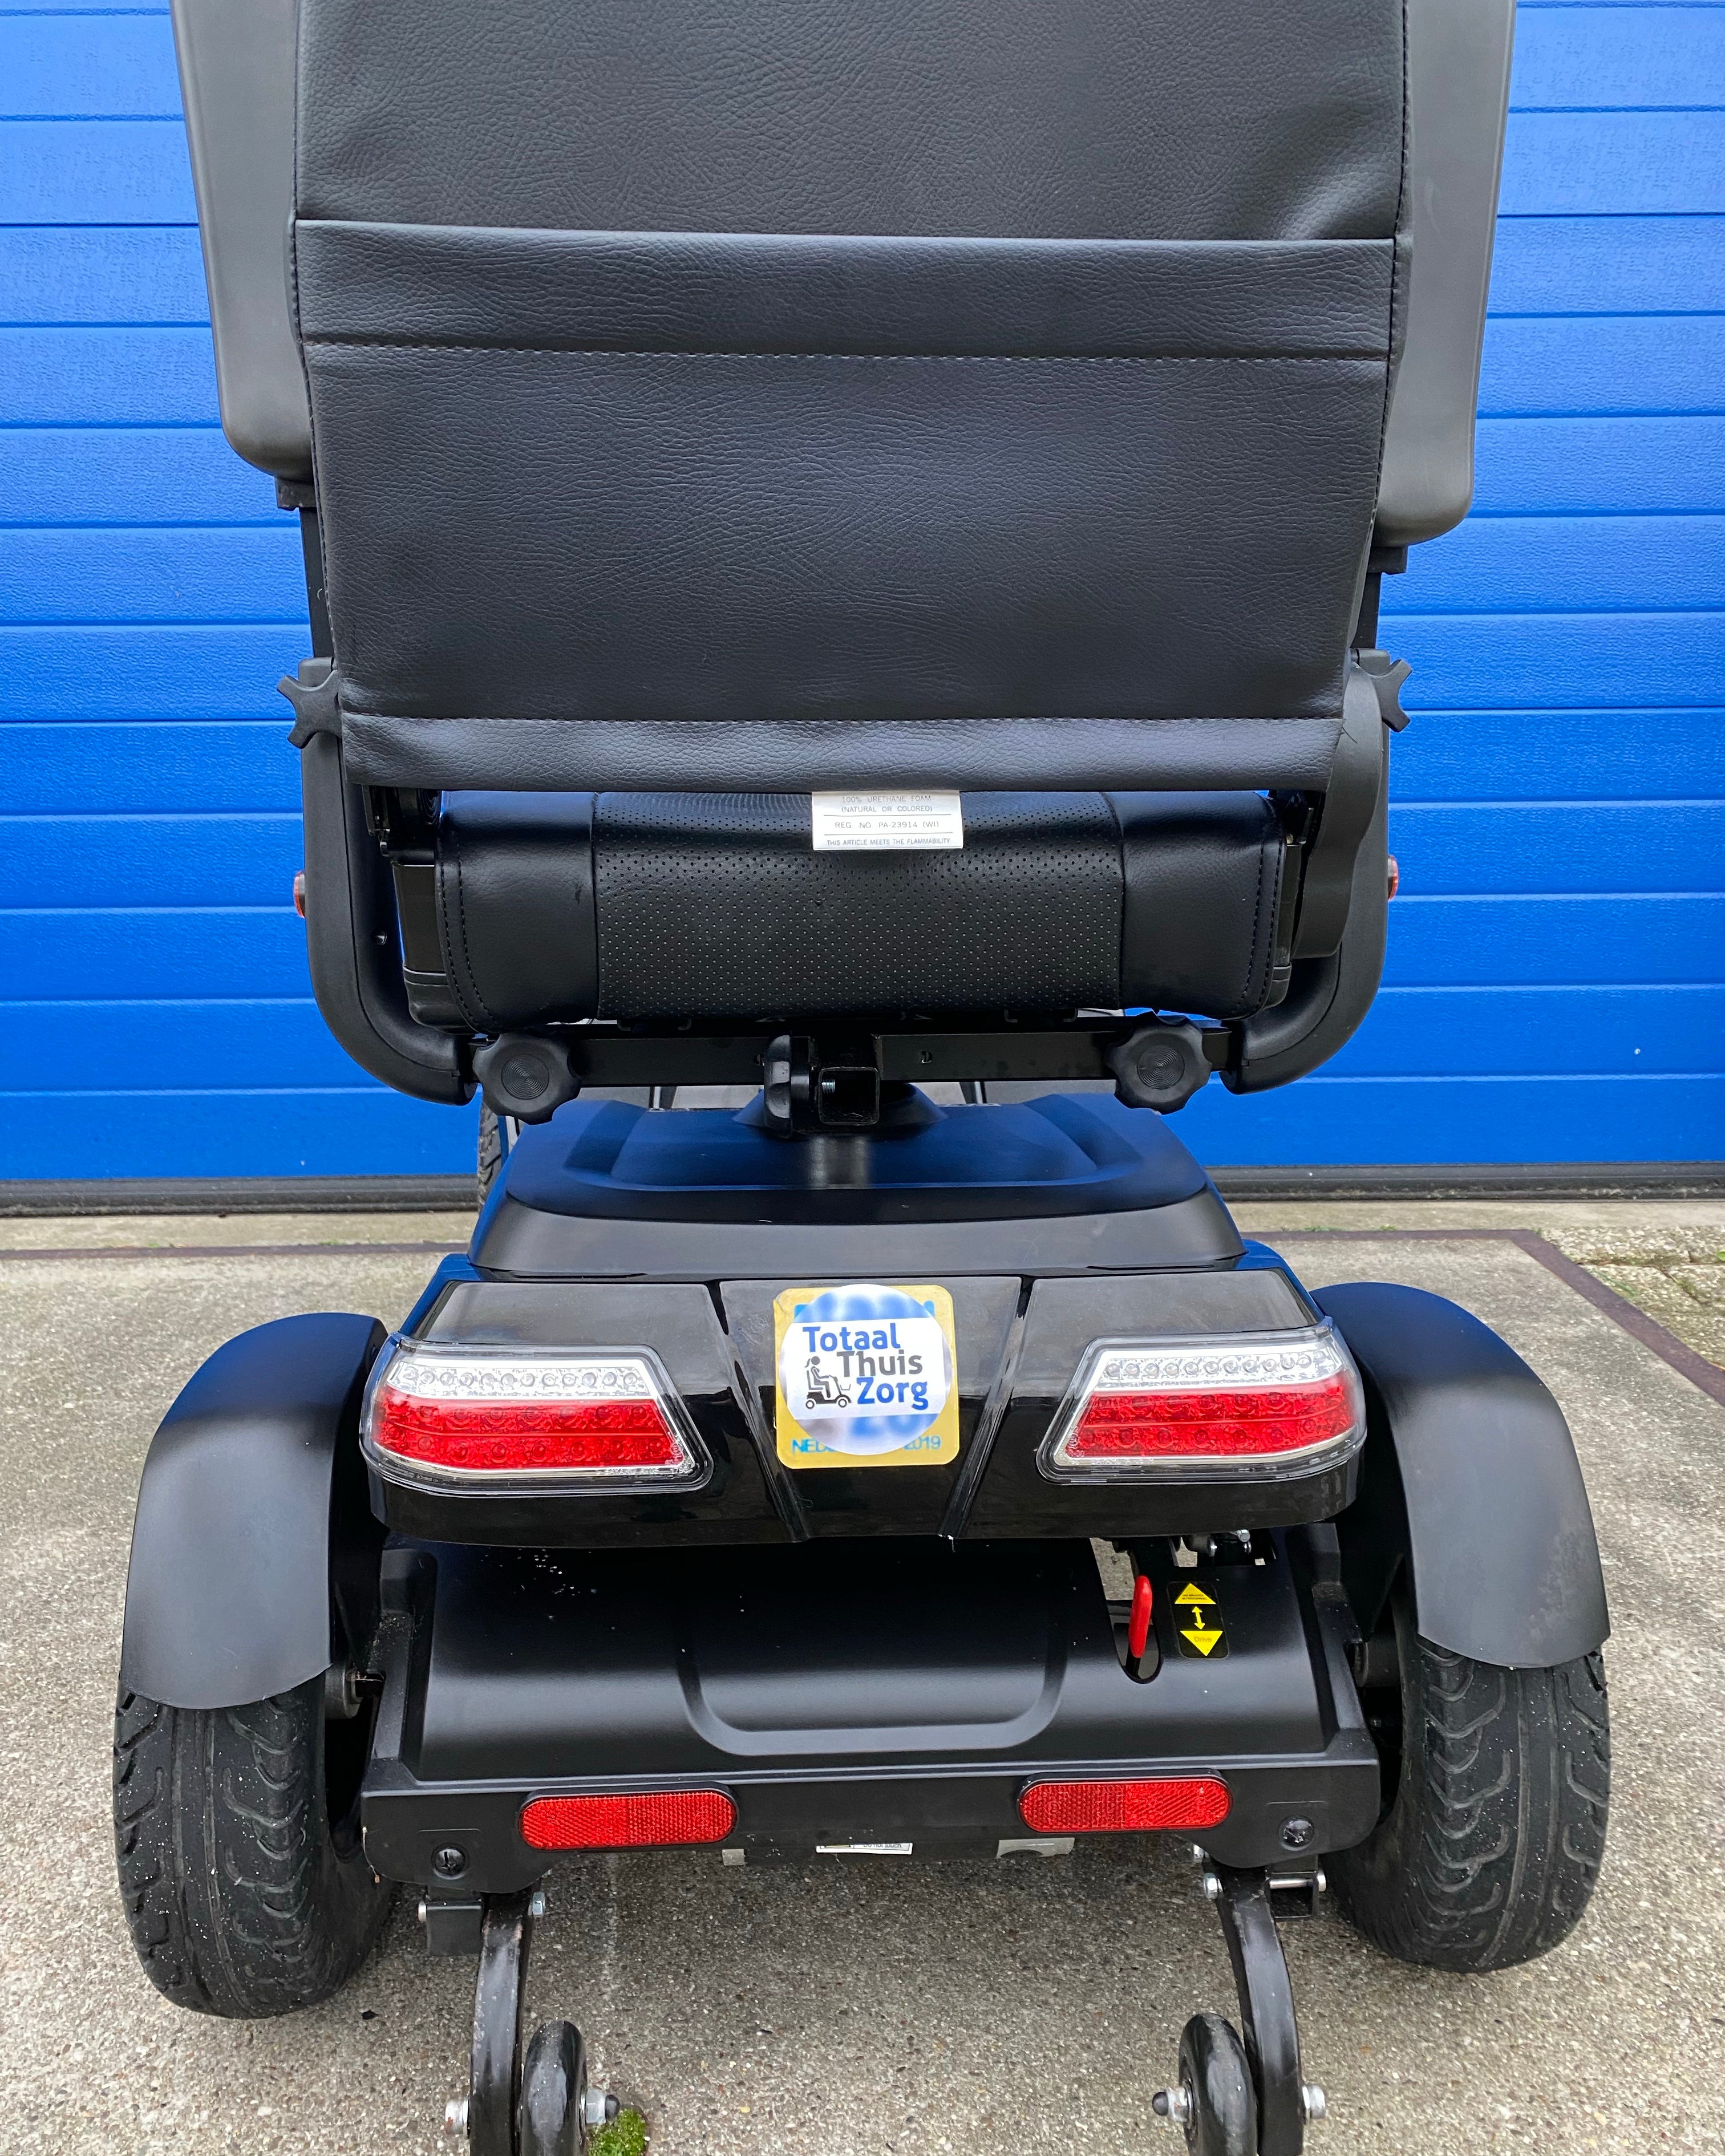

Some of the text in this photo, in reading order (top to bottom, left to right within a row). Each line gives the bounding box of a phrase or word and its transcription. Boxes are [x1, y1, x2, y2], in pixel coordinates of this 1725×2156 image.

[803, 1323, 901, 1352] Totaal
[836, 1349, 923, 1377] Thuis
[856, 1376, 929, 1410] Zorg
